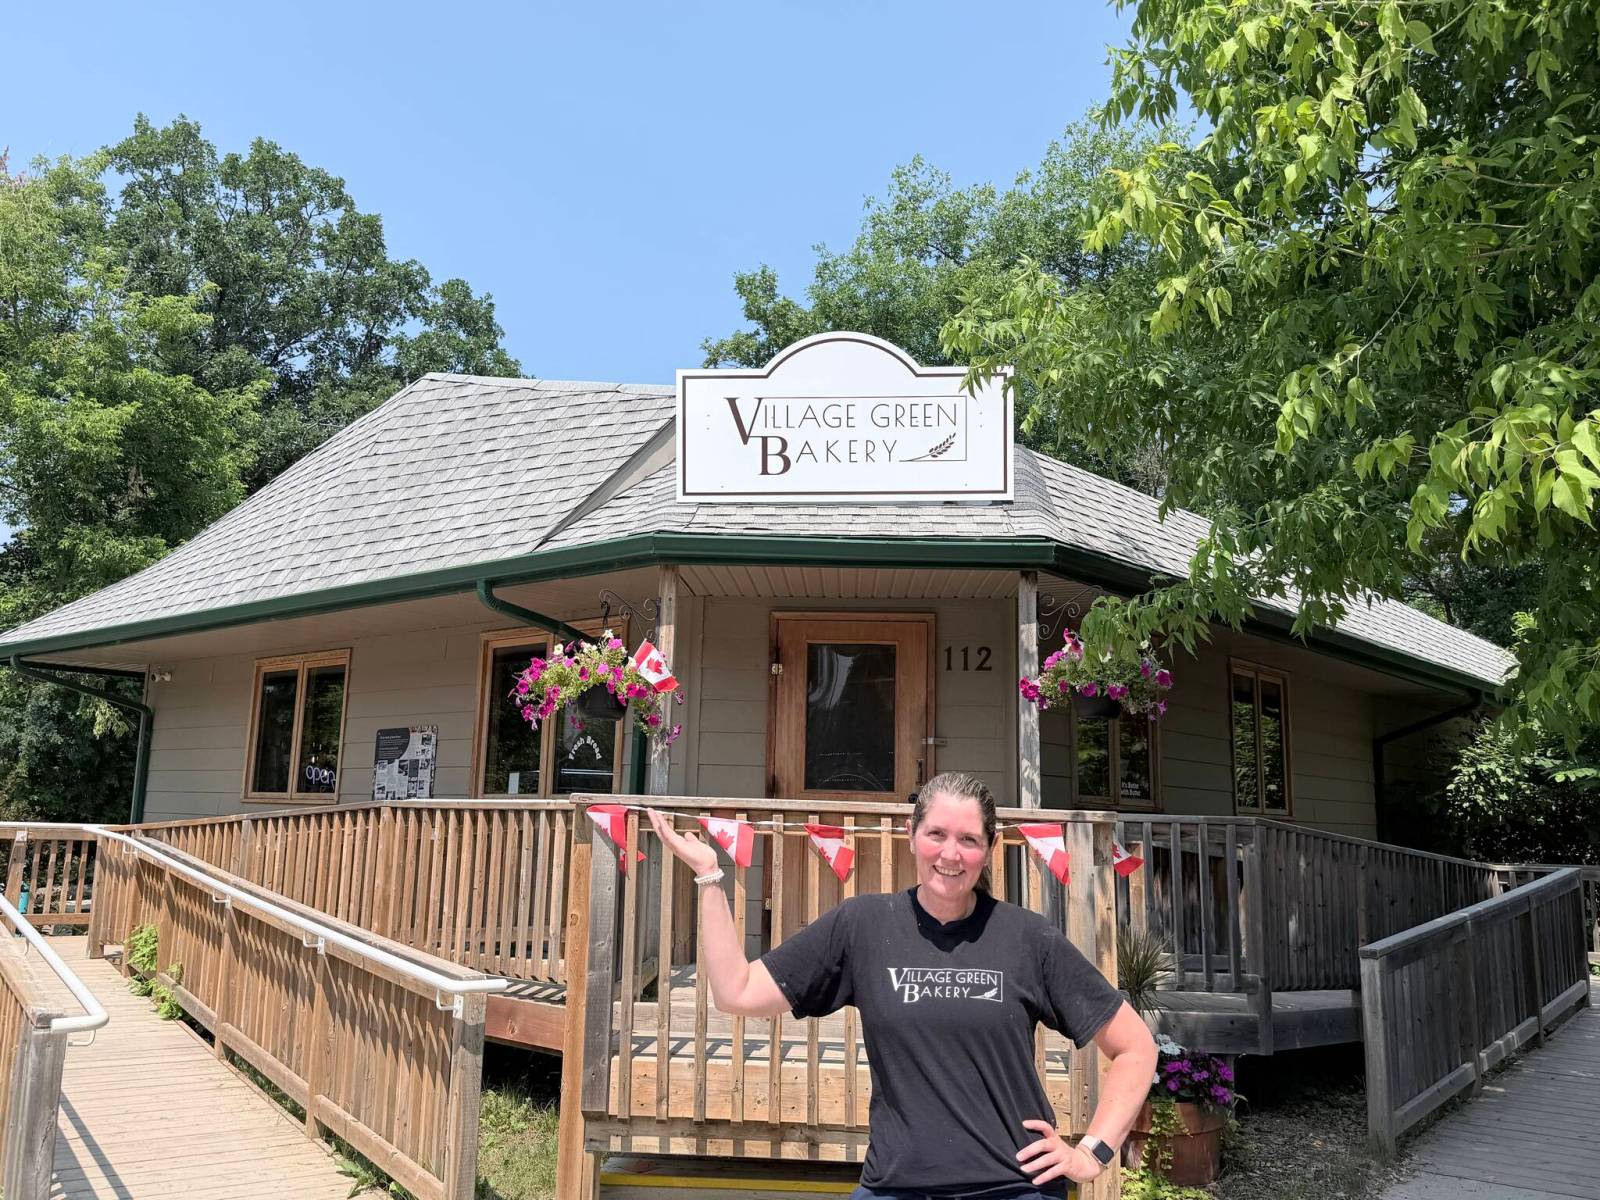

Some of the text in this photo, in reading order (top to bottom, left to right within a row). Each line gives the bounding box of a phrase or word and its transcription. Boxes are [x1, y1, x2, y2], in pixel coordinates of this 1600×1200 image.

[723, 397, 957, 446] VILLAGE GREEN
[757, 435, 898, 476] BAKERY
[944, 645, 993, 672] 112
[568, 735, 602, 760] Fresh Bread
[886, 967, 998, 992] VILLAGE GREEN
[902, 983, 970, 1003] BAKERY
